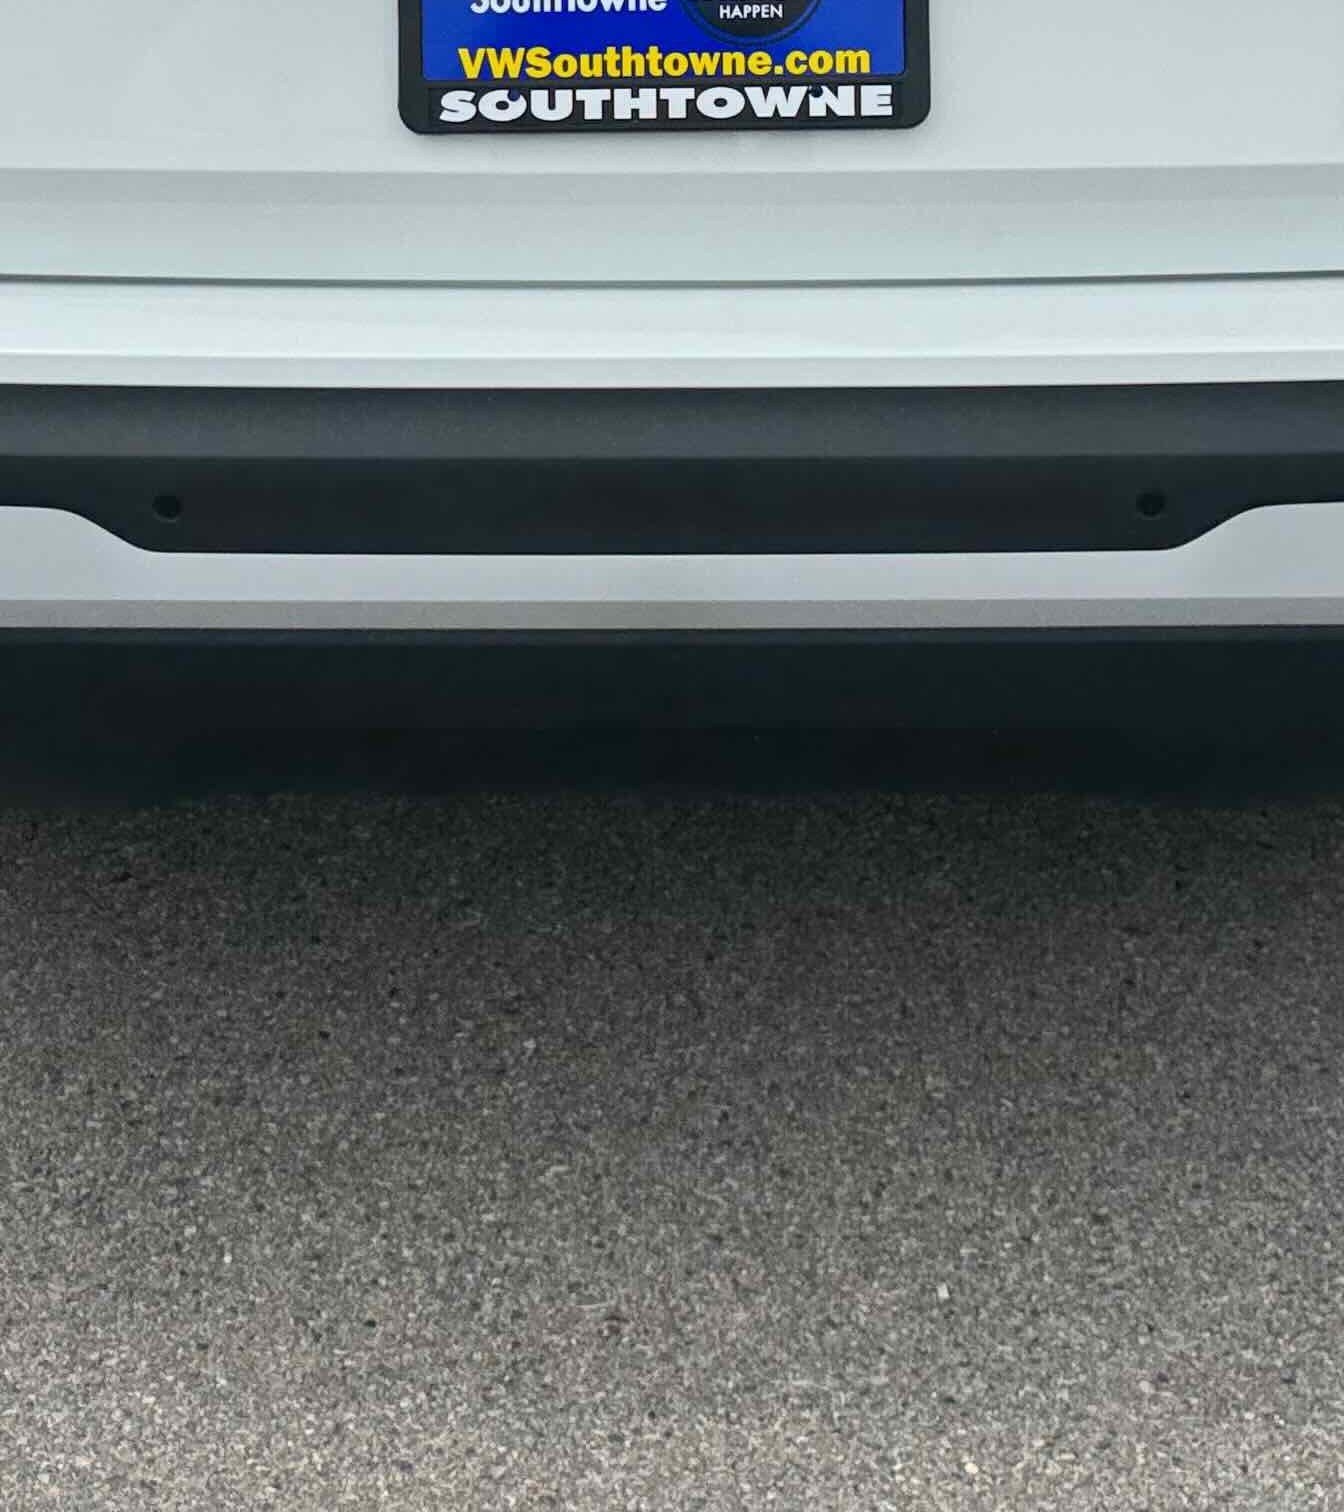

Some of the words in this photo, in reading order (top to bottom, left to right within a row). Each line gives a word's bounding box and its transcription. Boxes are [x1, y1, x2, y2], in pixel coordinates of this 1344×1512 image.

[719, 3, 784, 20] HAPPEN
[458, 45, 871, 81] VWSouthtowne.com
[438, 84, 894, 123] SOUTHTOWNE
